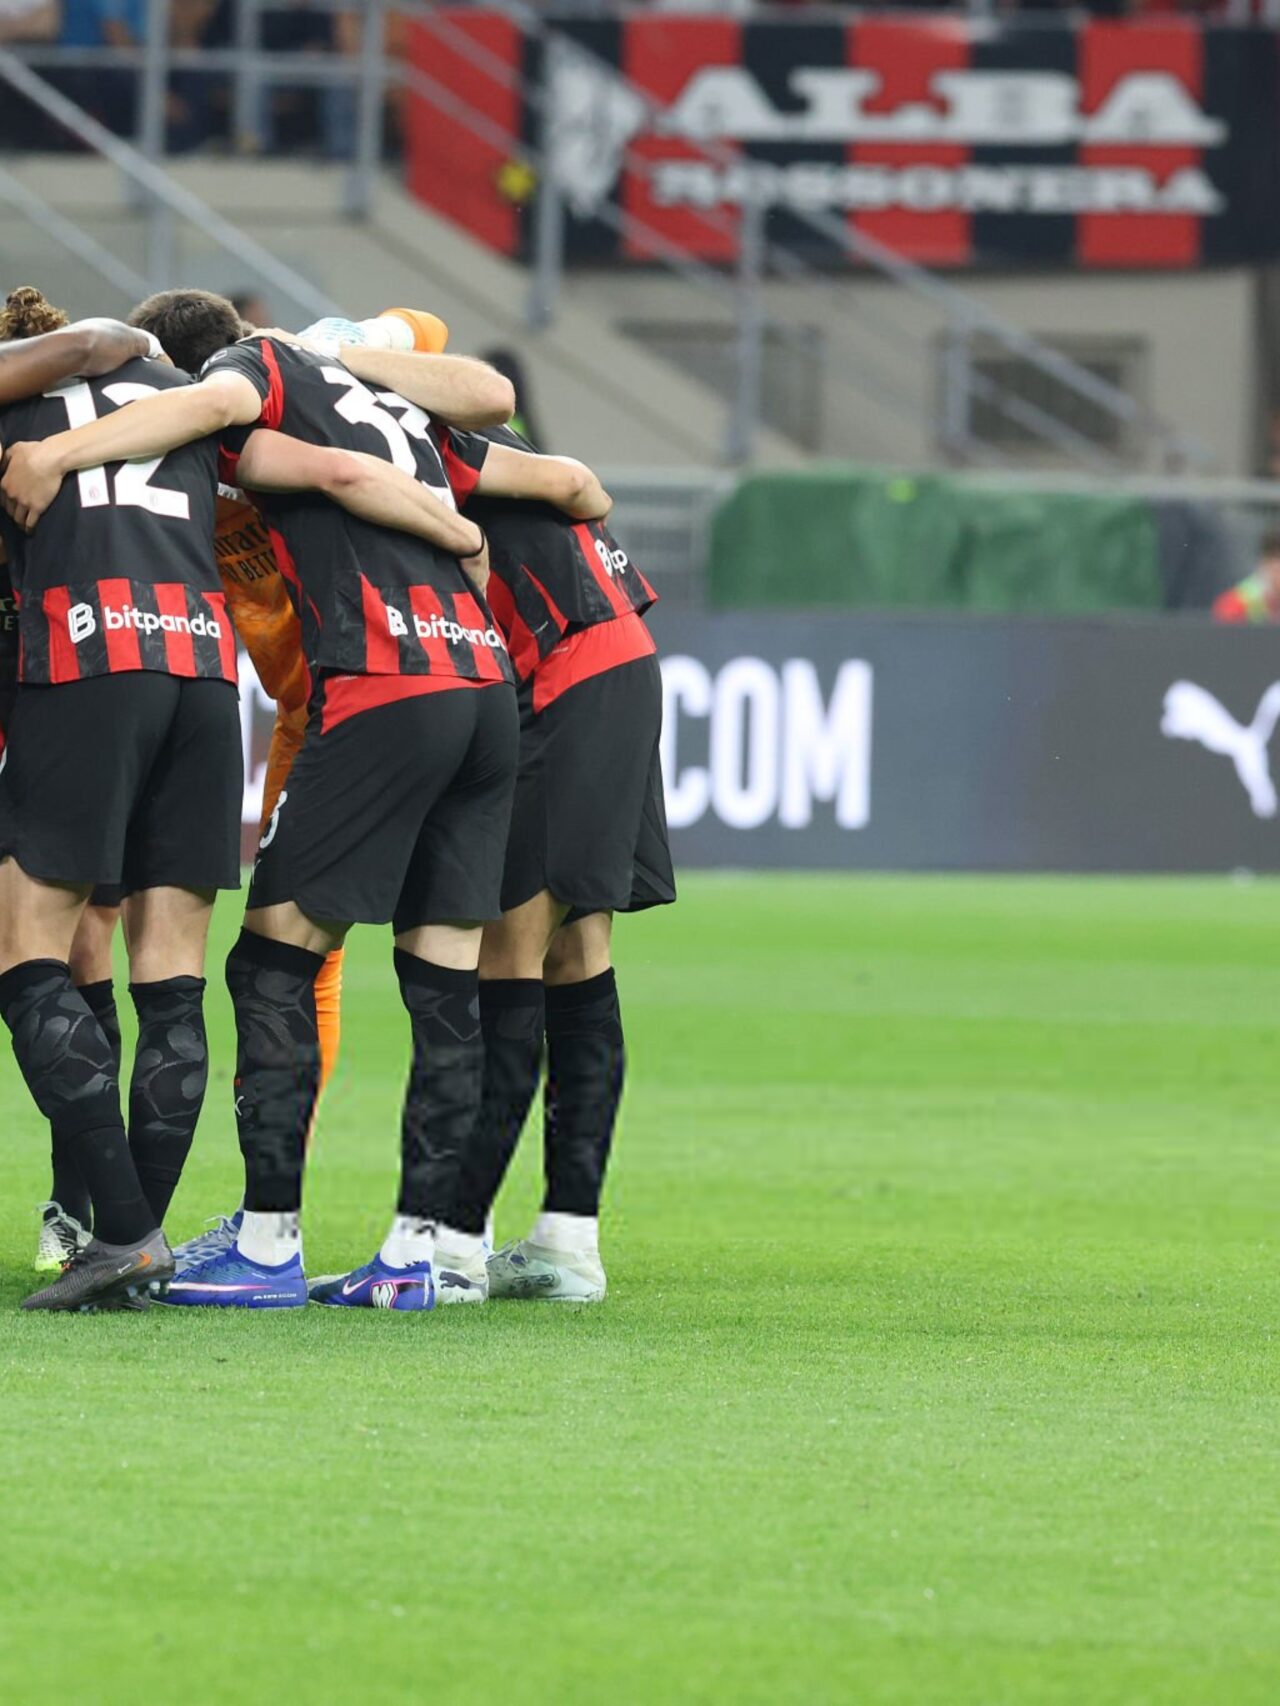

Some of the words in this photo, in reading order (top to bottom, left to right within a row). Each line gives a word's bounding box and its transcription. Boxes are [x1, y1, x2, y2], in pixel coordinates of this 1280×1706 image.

[654, 66, 1227, 145] ALBA
[652, 162, 1223, 213] ROSSONERA
[104, 604, 222, 639] bitpanda
[658, 655, 873, 830] COM
